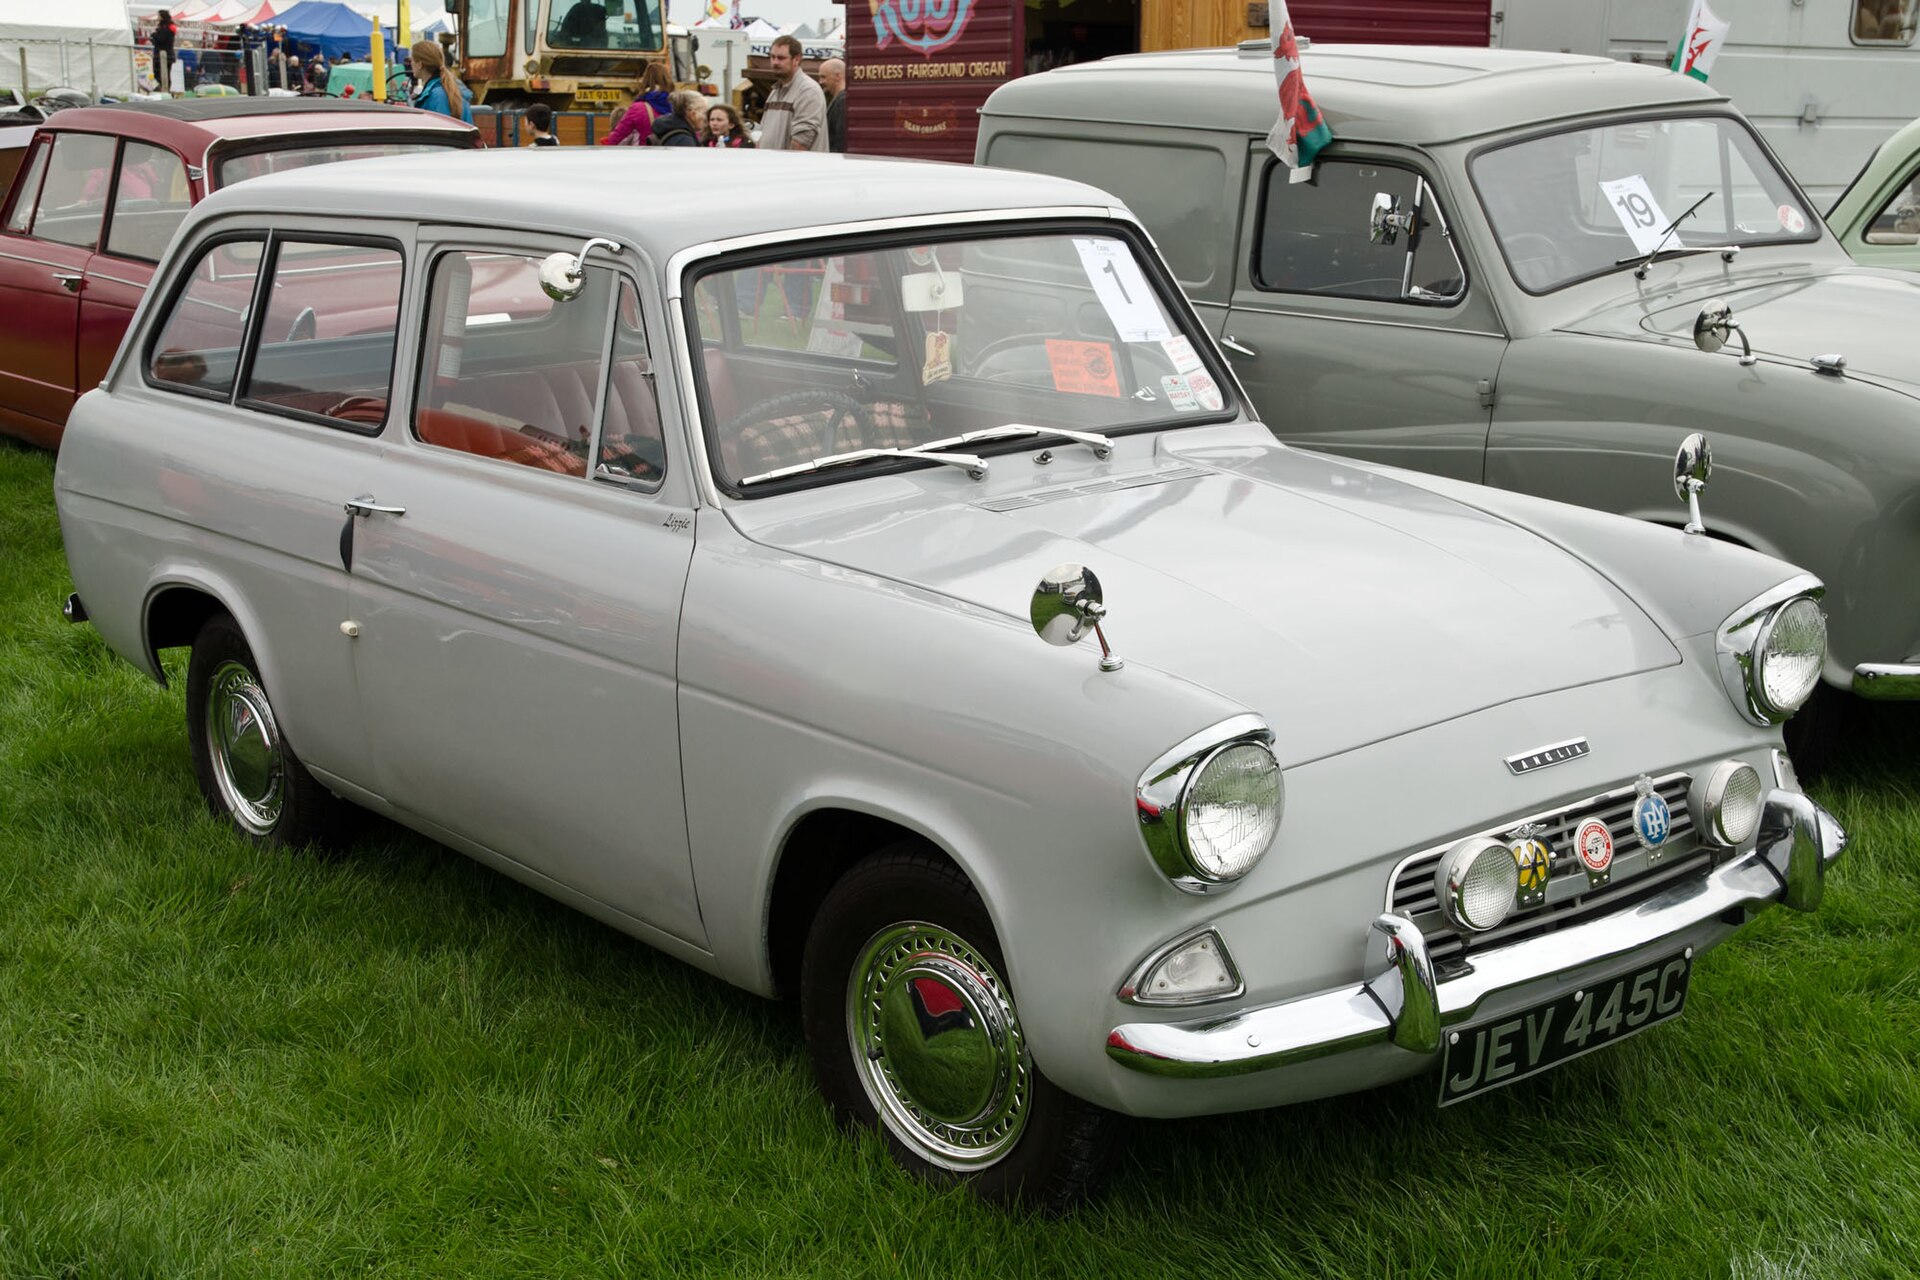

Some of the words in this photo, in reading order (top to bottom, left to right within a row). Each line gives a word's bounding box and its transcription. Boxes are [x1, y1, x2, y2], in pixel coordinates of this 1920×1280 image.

[853, 65, 865, 79] 30
[866, 64, 903, 79] KEYLESS
[907, 62, 966, 78] FAIRGROUND
[968, 61, 1007, 77] ORGAN
[1617, 193, 1656, 229] 19
[1103, 259, 1133, 304] 1
[1520, 744, 1583, 770] ANGLIA
[1449, 1006, 1556, 1094] JEV
[1562, 957, 1687, 1048] 445C
